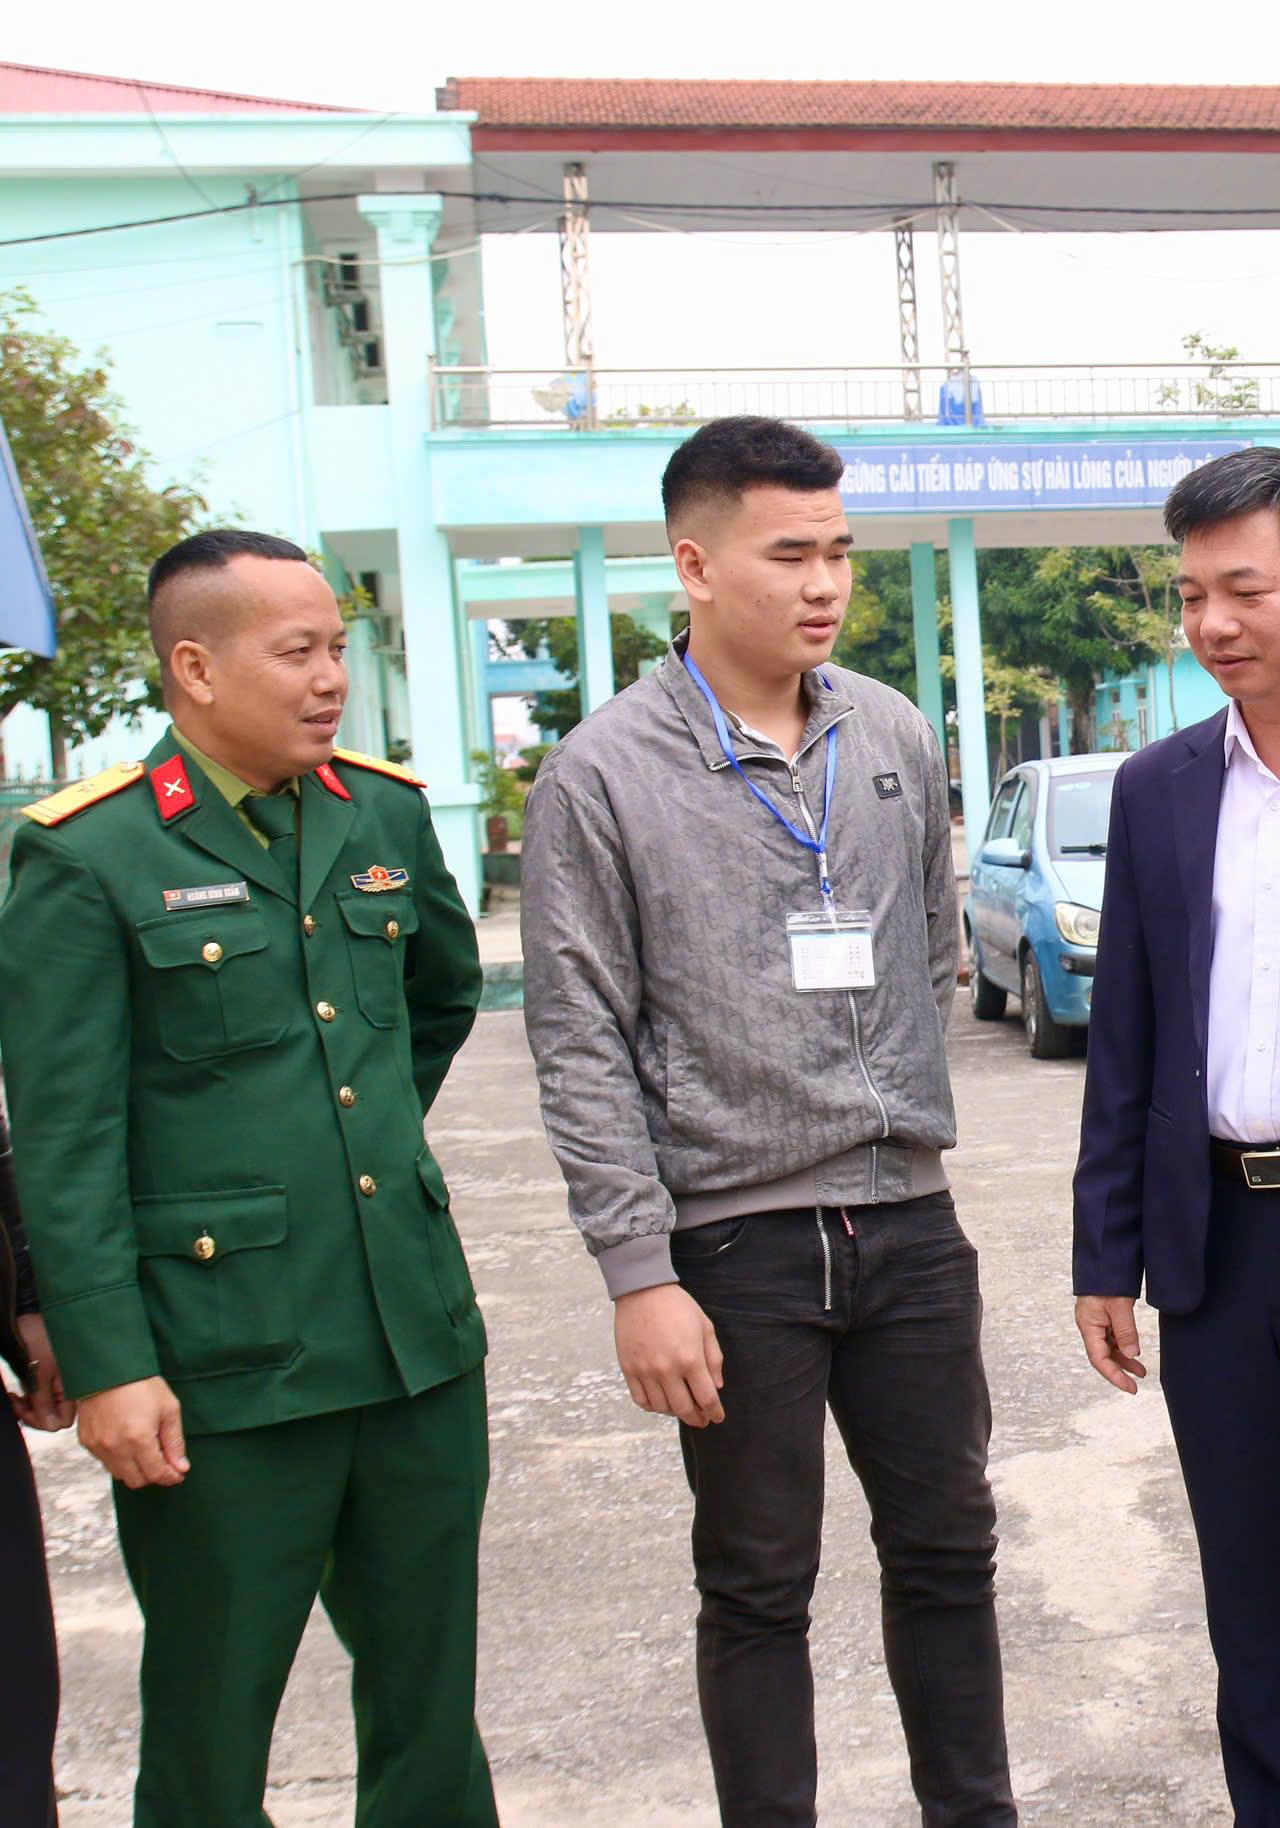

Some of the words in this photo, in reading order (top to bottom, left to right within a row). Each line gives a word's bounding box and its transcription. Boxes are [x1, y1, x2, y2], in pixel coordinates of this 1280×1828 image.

[888, 453, 915, 492] CẢI
[915, 453, 950, 491] TIẾN
[952, 456, 985, 491] ĐÁP
[987, 456, 1019, 491] ỨNG
[1021, 458, 1044, 496] SỰ
[1044, 454, 1070, 489] HÀI
[1072, 453, 1112, 489] LÒNG
[1114, 449, 1145, 489] CỦA
